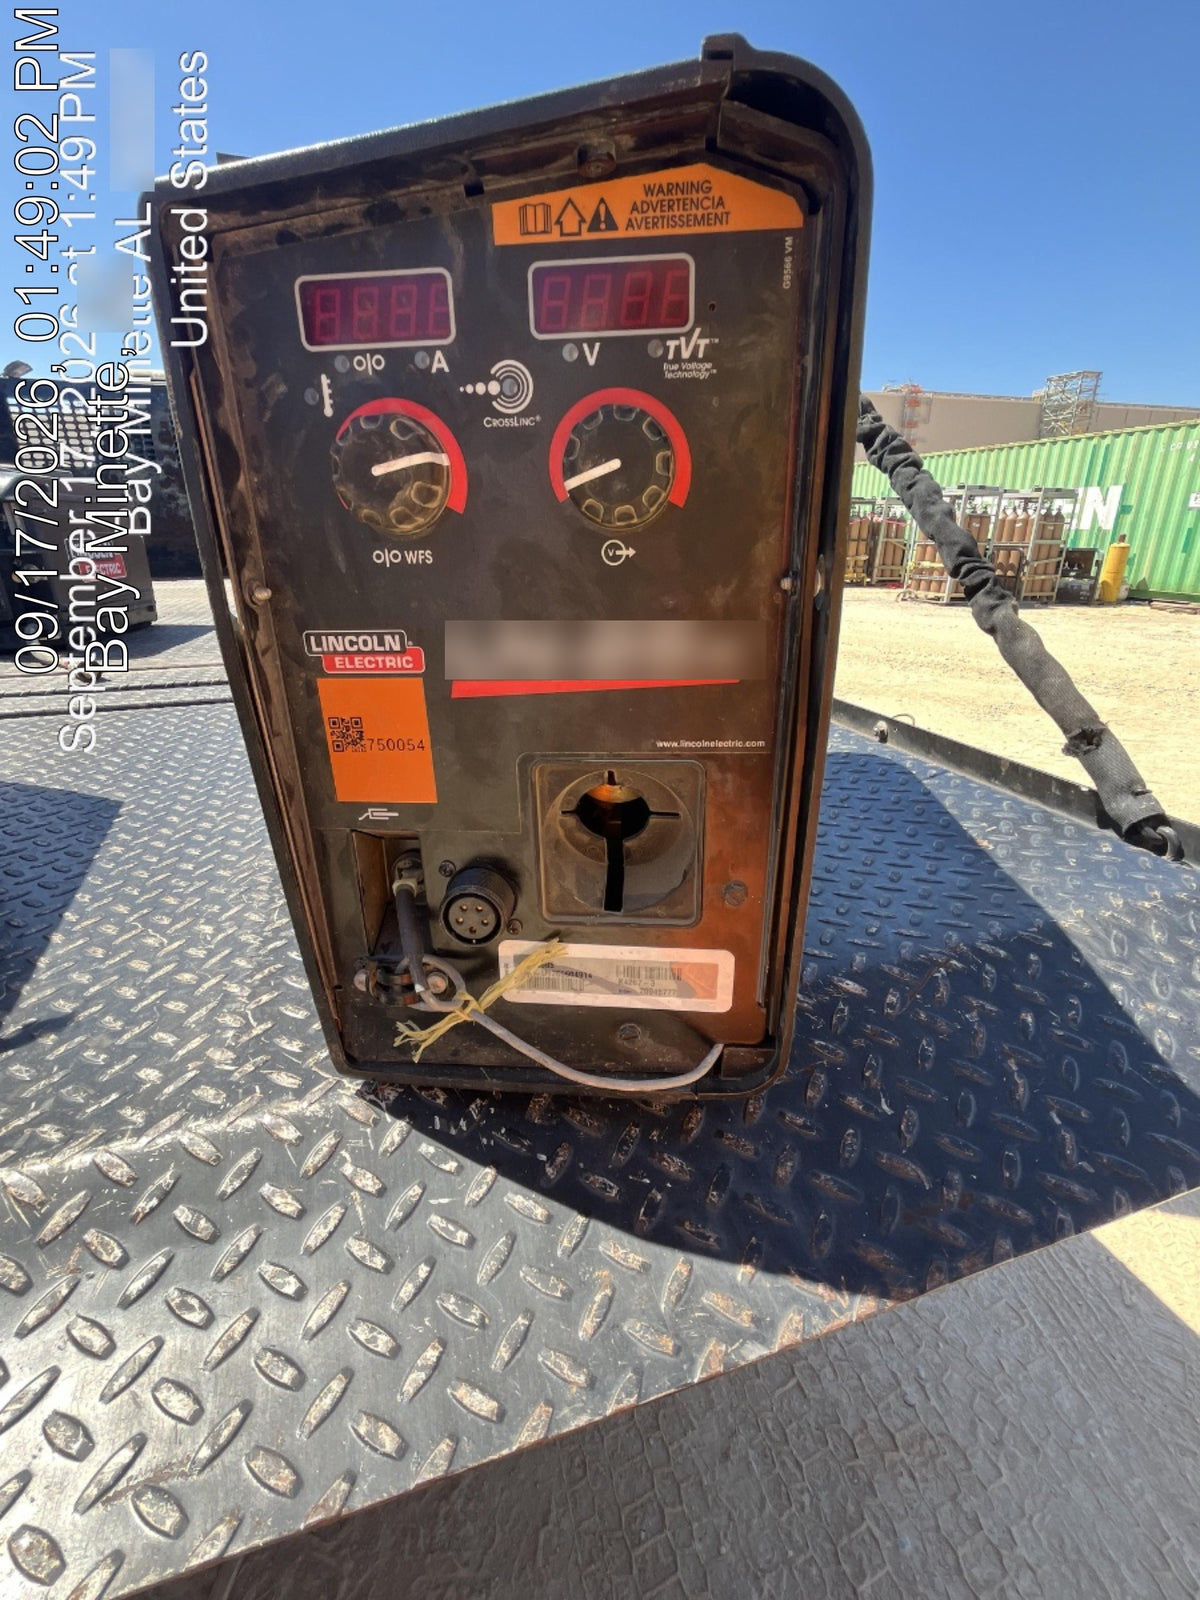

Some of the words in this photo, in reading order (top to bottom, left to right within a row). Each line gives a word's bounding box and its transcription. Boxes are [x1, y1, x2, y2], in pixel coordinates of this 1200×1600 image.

[643, 179, 713, 198] WARNING
[630, 196, 726, 215] ADVERTENCIA
[625, 211, 730, 232] AVERTISSEMENT
[431, 350, 449, 373] A
[583, 342, 600, 366] V
[681, 361, 712, 372] Voltage
[404, 550, 433, 566] WFS
[309, 634, 401, 652] LINCOLN
[333, 656, 414, 669] ELECTRIC
[367, 738, 425, 752] 750054
[656, 739, 765, 748] www.lincolnelectric.com
